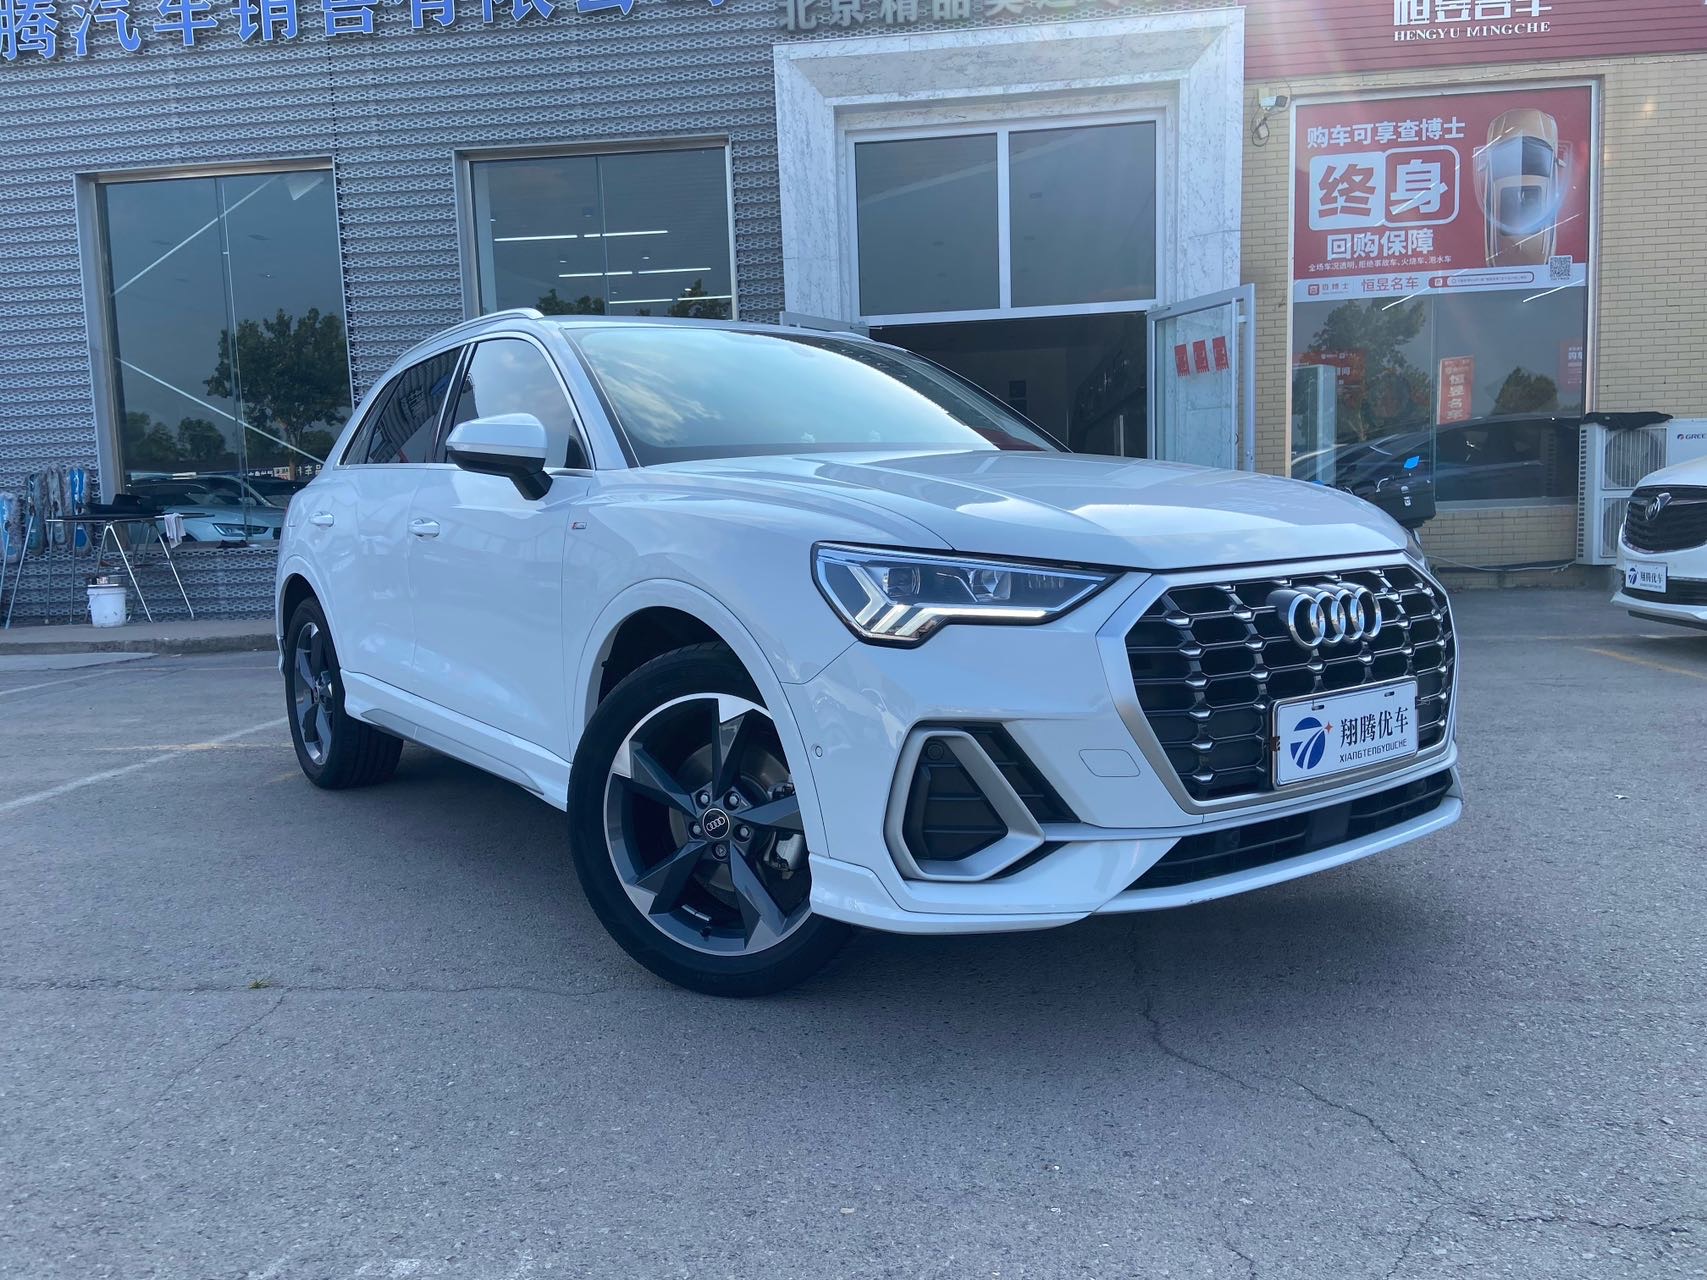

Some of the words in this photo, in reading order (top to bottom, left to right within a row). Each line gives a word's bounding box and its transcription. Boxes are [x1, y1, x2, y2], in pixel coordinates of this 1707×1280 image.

[1393, 27, 1460, 42] HENGYU
[1466, 21, 1551, 38] MINGCHE
[1306, 116, 1466, 149] 购车可享查博士
[1317, 158, 1449, 220] 终身
[1326, 228, 1435, 261] 回购保障
[1361, 276, 1420, 293] 恒昱名车
[1340, 706, 1409, 748] 翔腾优车
[1339, 738, 1408, 763] XIANGTENGYOUCHE
